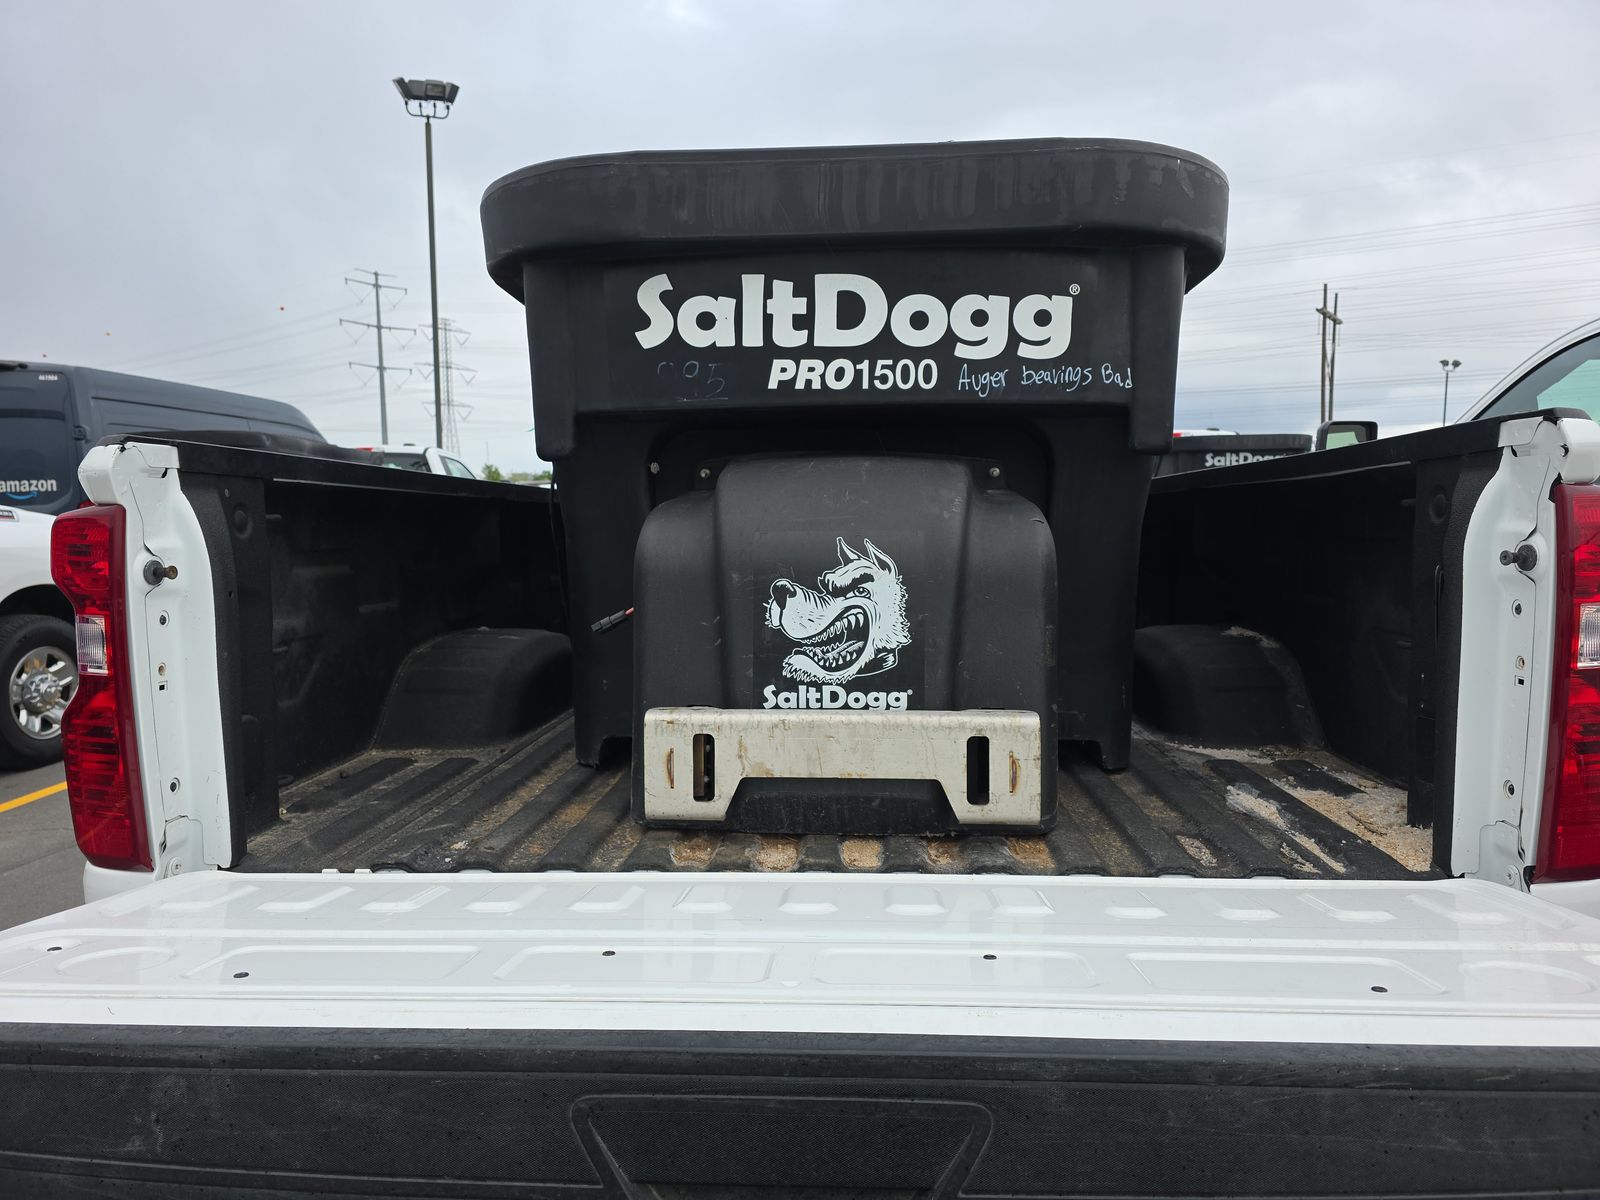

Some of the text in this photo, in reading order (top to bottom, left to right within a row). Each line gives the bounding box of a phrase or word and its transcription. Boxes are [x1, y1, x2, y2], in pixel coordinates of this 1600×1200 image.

[767, 358, 938, 390] PRO1500
[958, 362, 1133, 398] Auger bearings Bad
[1205, 452, 1285, 468] SaltDo
[0, 479, 58, 493] amazon
